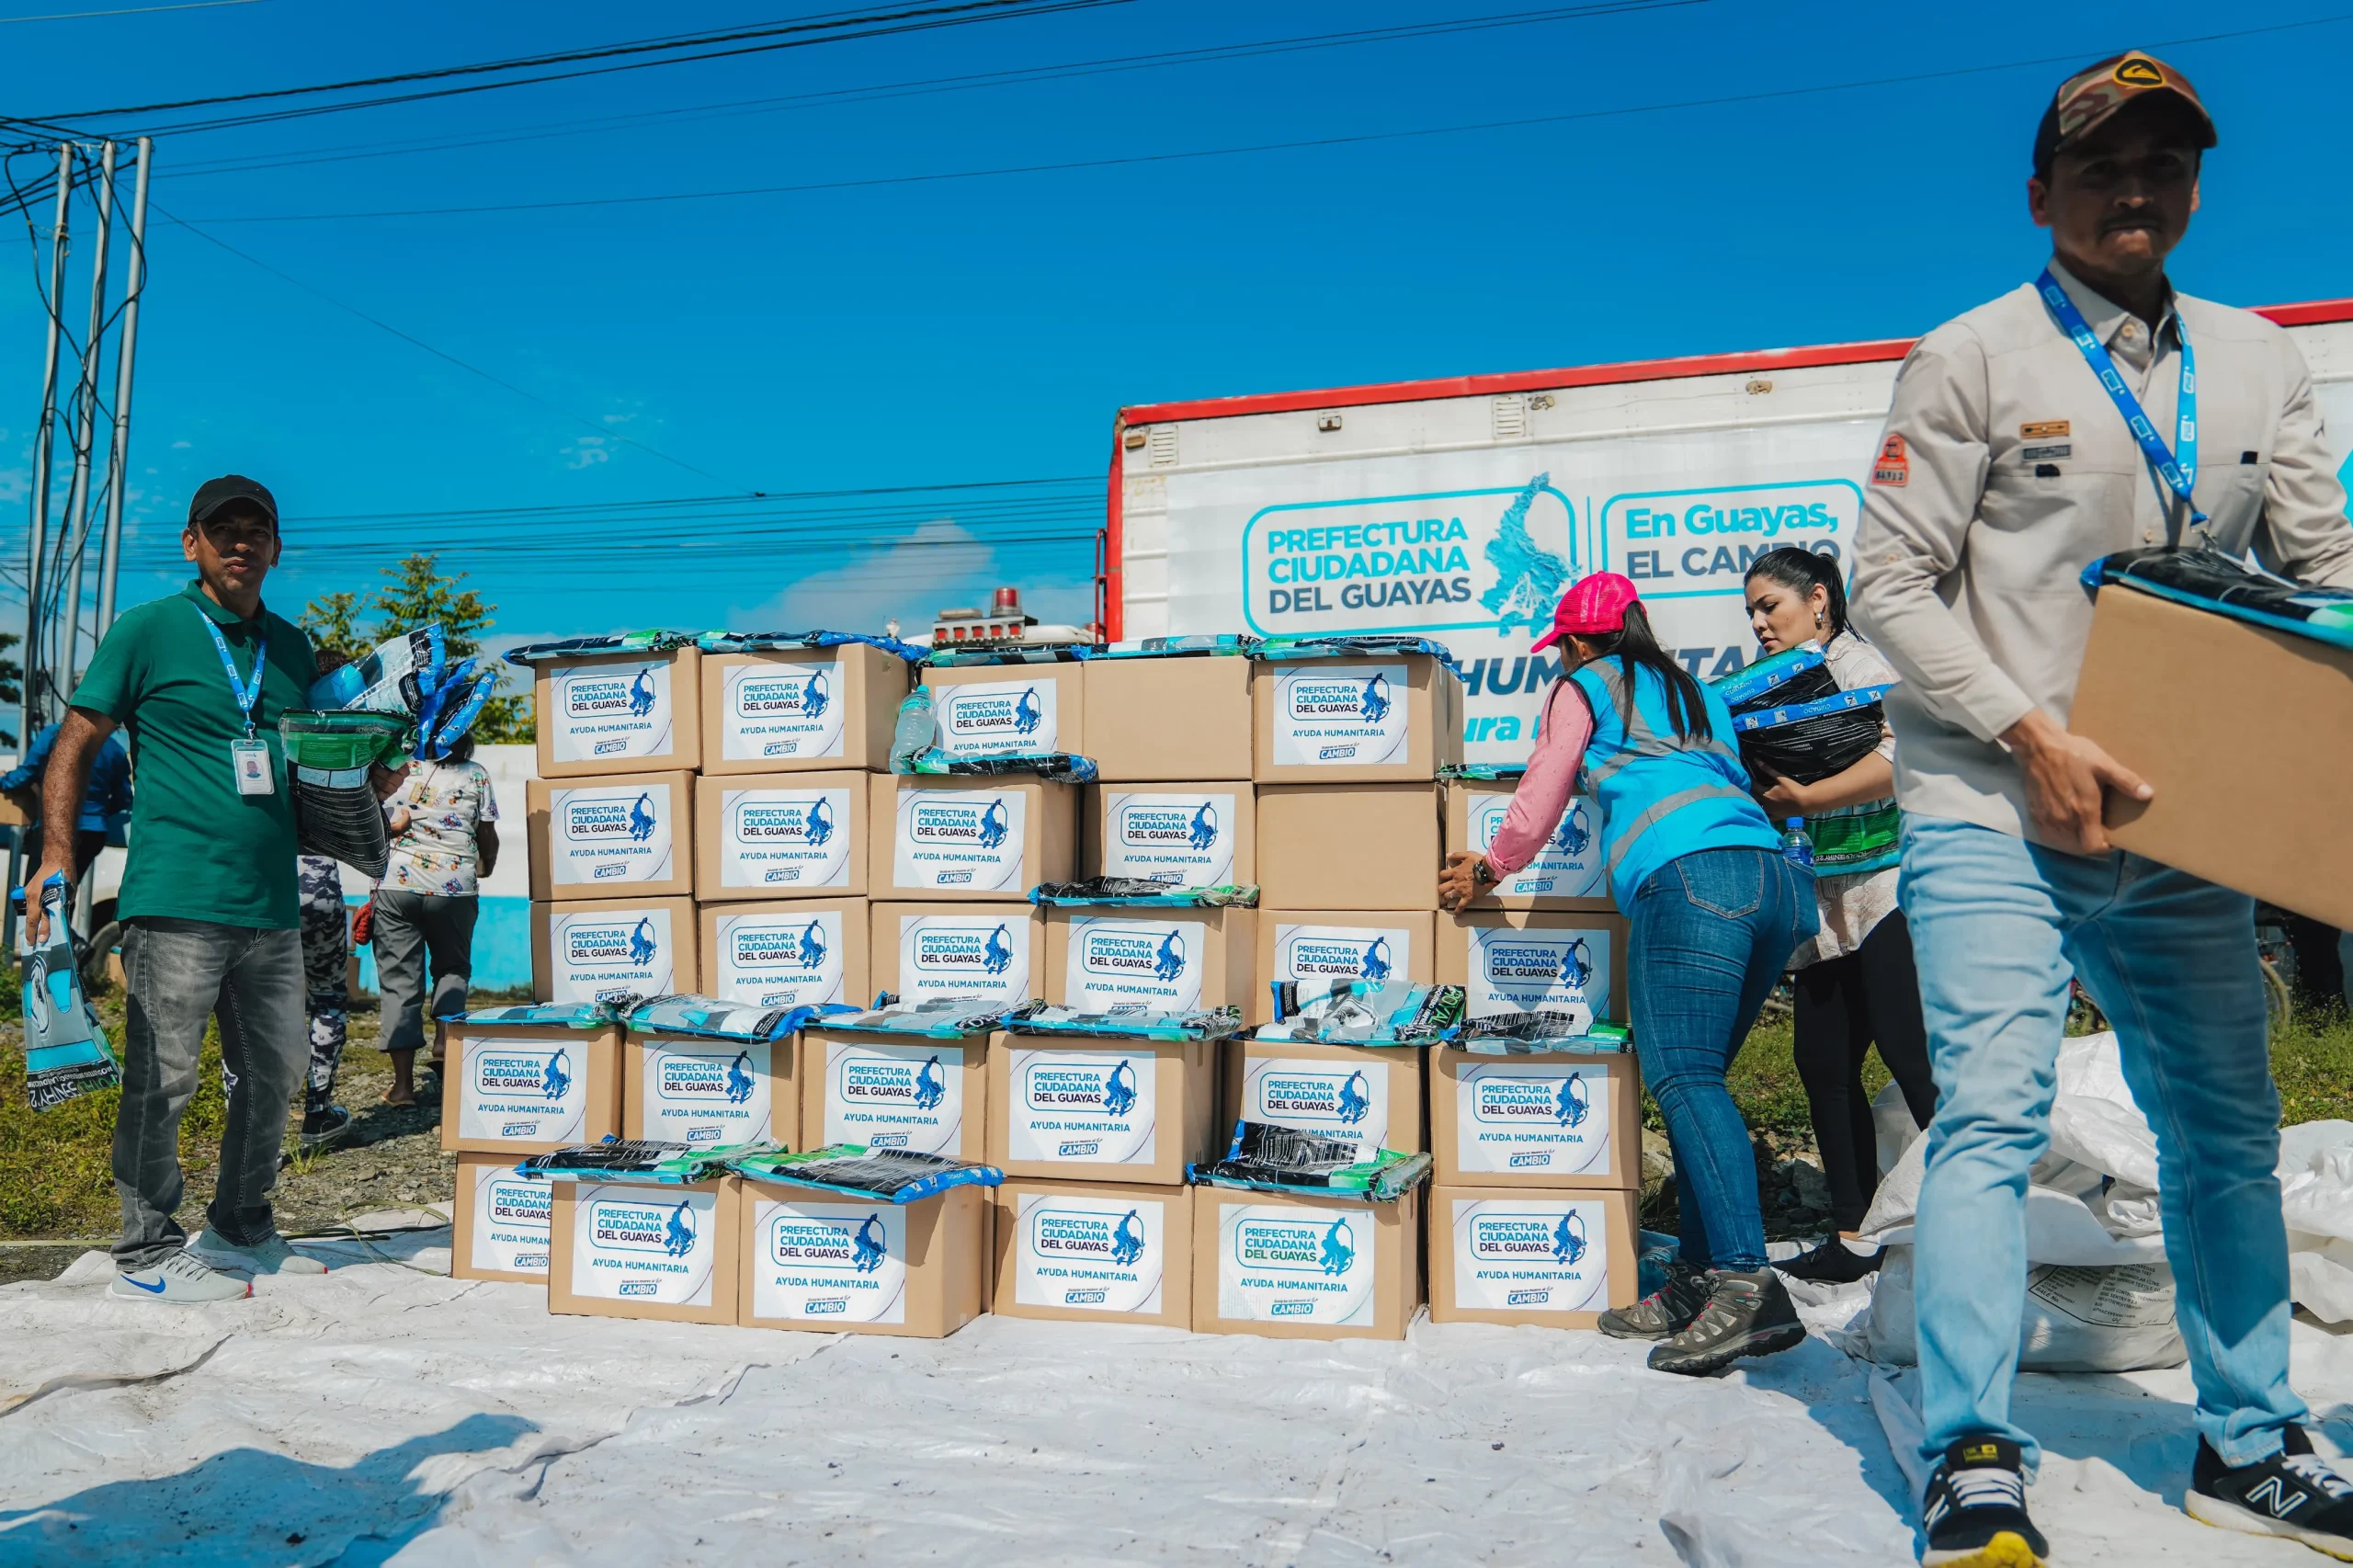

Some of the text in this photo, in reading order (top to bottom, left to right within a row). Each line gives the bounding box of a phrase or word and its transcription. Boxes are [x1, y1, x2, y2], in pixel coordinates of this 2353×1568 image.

[1626, 502, 1839, 540] En Guayas,
[1267, 517, 1469, 554] PREFECTURA
[1267, 545, 1471, 584] CIUDADANA
[1627, 550, 1675, 579] EL
[1269, 576, 1472, 614] DEL GUAYAS
[571, 682, 626, 694] PREFECTURA
[744, 683, 800, 693] PREFECTURA
[1296, 686, 1358, 695] PREFECTURA
[572, 690, 627, 703] CIUDADANA
[744, 691, 800, 702] CIUDADANA
[1296, 694, 1358, 704] CIUDADANA
[572, 699, 628, 711] DEL GUAYAS
[743, 700, 800, 711] DEL GUAYAS
[956, 700, 1012, 711] PREFECTURA
[1296, 704, 1358, 713] DEL GUAYAS
[956, 708, 1012, 720] CIUDADANA
[956, 717, 1012, 729] DEL GUAYAS
[740, 723, 824, 735] AYUDA HUMANITARIA
[1320, 747, 1354, 759] CAMBIO
[571, 805, 626, 816] PREFECTURA
[743, 809, 802, 817] PREFECTURA
[918, 809, 977, 818] PREFECTURA
[572, 813, 627, 825] CIUDADANA
[744, 817, 802, 827] CIUDADANA
[1128, 812, 1187, 821] PREFECTURA
[917, 817, 977, 828] CIUDADANA
[1128, 822, 1187, 830] CIUDADANA
[572, 823, 627, 834] DEL GUAYAS
[743, 827, 802, 836] DEL GUAYAS
[916, 827, 977, 837] DEL GUAYAS
[1127, 831, 1187, 839] DEL GUAYAS
[912, 852, 1001, 863] AYUDA HUMANITARIA
[570, 930, 626, 940] PREFECTURA
[737, 933, 796, 942] PREFECTURA
[921, 936, 981, 944] PREFECTURA
[571, 938, 627, 949] CIUDADANA
[738, 941, 796, 952] CIUDADANA
[1090, 937, 1153, 949] PREFECTURA
[571, 948, 628, 958] DEL GUAYAS
[921, 945, 982, 954] CIUDADANA
[1090, 947, 1153, 960] CIUDADANA
[1297, 945, 1358, 956] PREFECTURA
[1492, 949, 1557, 958] PREFECTURA
[738, 950, 797, 961] DEL GUAYAS
[921, 954, 982, 963] DEL GUAYAS
[1297, 954, 1358, 965] CIUDADANA
[1089, 956, 1153, 969] DEL GUAYAS
[1492, 958, 1558, 968] CIUDADANA
[1296, 963, 1358, 975] DEL GUAYAS
[1492, 967, 1558, 978] DEL GUAYAS
[1428, 987, 1464, 1026] ROYAL
[483, 1059, 540, 1068] PREFECTURA
[665, 1063, 723, 1072] PREFECTURA
[483, 1068, 540, 1078] CIUDADANA
[848, 1066, 912, 1076] PREFECTURA
[665, 1073, 723, 1082] CIUDADANA
[848, 1075, 912, 1087] CIUDADANA
[1034, 1072, 1101, 1082] PREFECTURA
[482, 1078, 540, 1088] DEL GUAYAS
[664, 1082, 723, 1092] DEL GUAYAS
[1034, 1082, 1101, 1093] CIUDADANA
[1267, 1080, 1335, 1091] PREFECTURA
[847, 1085, 912, 1097] DEL GUAYAS
[1482, 1085, 1552, 1094] PREFECTURA
[1033, 1093, 1101, 1104] DEL GUAYAS
[1267, 1090, 1335, 1101] CIUDADANA
[1482, 1095, 1552, 1105] CIUDADANA
[1267, 1100, 1335, 1111] DEL GUAYAS
[1482, 1105, 1552, 1115] DEL GUAYAS
[1029, 1120, 1131, 1132] AYUDA HUMANITARIA
[1479, 1132, 1584, 1143] AYUDA HUMANITARIA
[1060, 1143, 1097, 1155] CAMBIO
[1511, 1154, 1549, 1166] CAMBIO
[597, 1209, 662, 1221] PREFECTURA
[597, 1219, 662, 1233] CIUDADANA
[779, 1225, 849, 1236] PREFECTURA
[1041, 1219, 1108, 1231] PREFECTURA
[1478, 1222, 1549, 1232] PREFECTURA
[597, 1230, 662, 1244] DEL GUAYAS
[1041, 1228, 1109, 1242] CIUDADANA
[1245, 1228, 1316, 1240] PREFECTURA
[1479, 1233, 1550, 1242] CIUDADANA
[779, 1235, 849, 1248] CIUDADANA
[1040, 1239, 1108, 1253] DEL GUAYAS
[1245, 1238, 1317, 1251] CIUDADANA
[779, 1247, 849, 1259] DEL GUAYAS
[1479, 1243, 1551, 1253] DEL GUAYAS
[1245, 1249, 1317, 1262] DEL GUAYAS
[775, 1277, 880, 1290] AYUDA HUMANITARIA
[1240, 1278, 1348, 1292] AYUDA HUMANITARIA
[620, 1284, 656, 1295] CAMBIO
[1508, 1292, 1547, 1304] CAMBIO
[806, 1301, 845, 1313] CAMBIO
